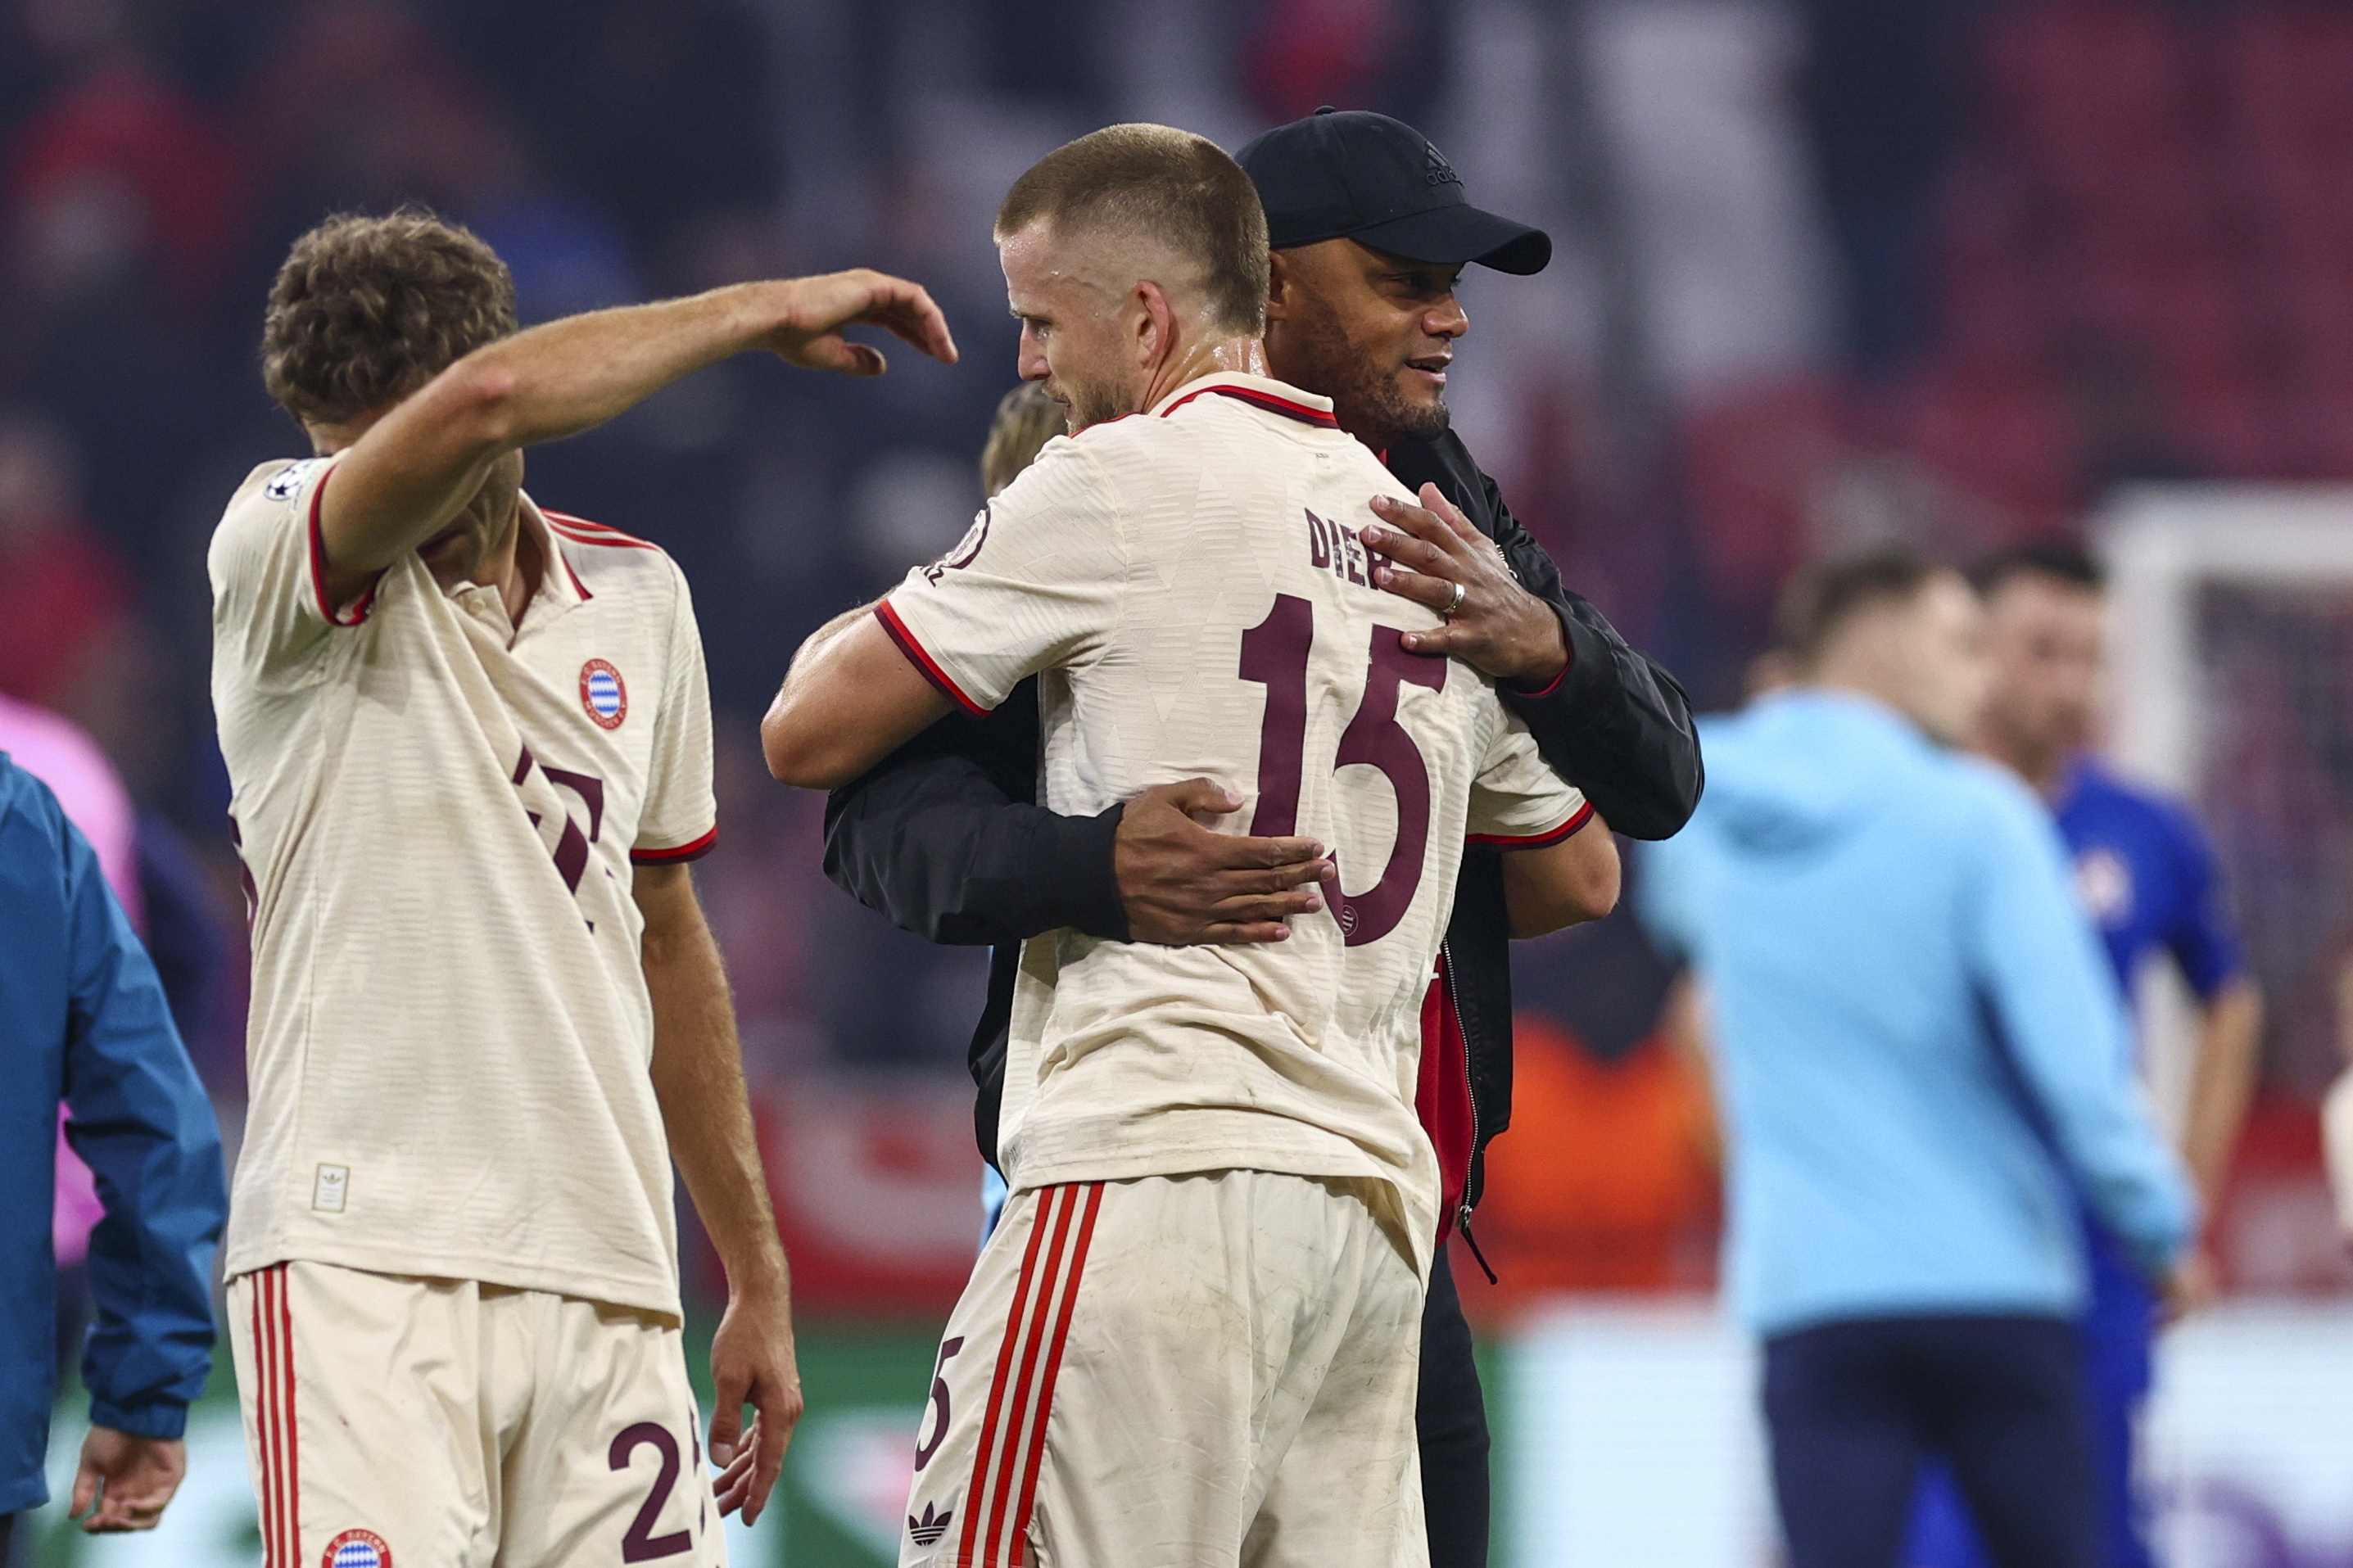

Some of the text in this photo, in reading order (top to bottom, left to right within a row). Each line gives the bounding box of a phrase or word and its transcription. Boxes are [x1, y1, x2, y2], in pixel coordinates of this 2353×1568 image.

[1238, 592, 1447, 947] 15
[914, 1335, 965, 1472] 5
[609, 1404, 706, 1564] 2
